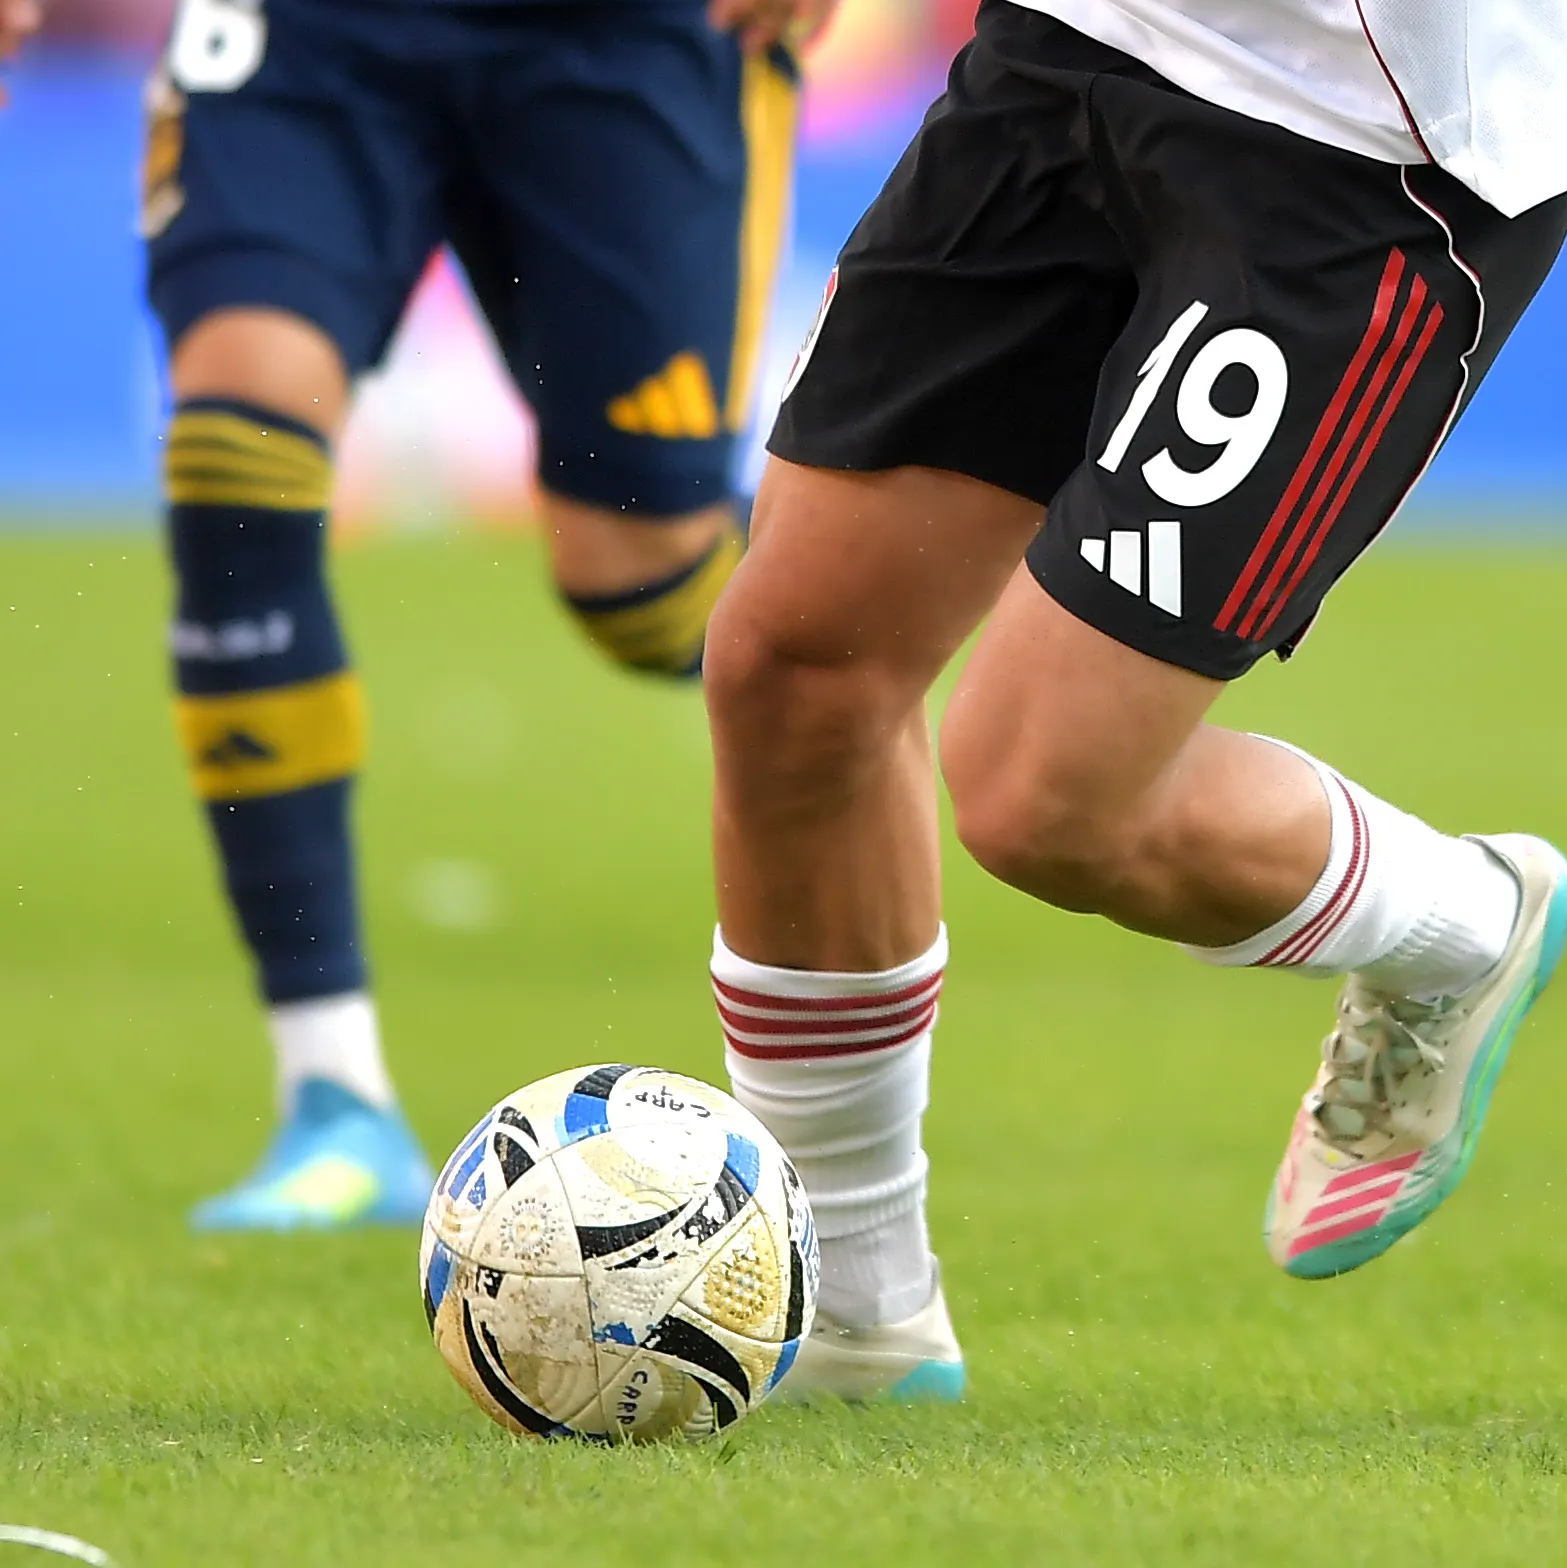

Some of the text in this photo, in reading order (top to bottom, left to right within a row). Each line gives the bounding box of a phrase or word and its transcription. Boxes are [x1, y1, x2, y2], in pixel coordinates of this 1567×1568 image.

[1096, 299, 1289, 508] 19
[634, 1091, 711, 1119] CARP
[616, 1370, 648, 1425] CARP
